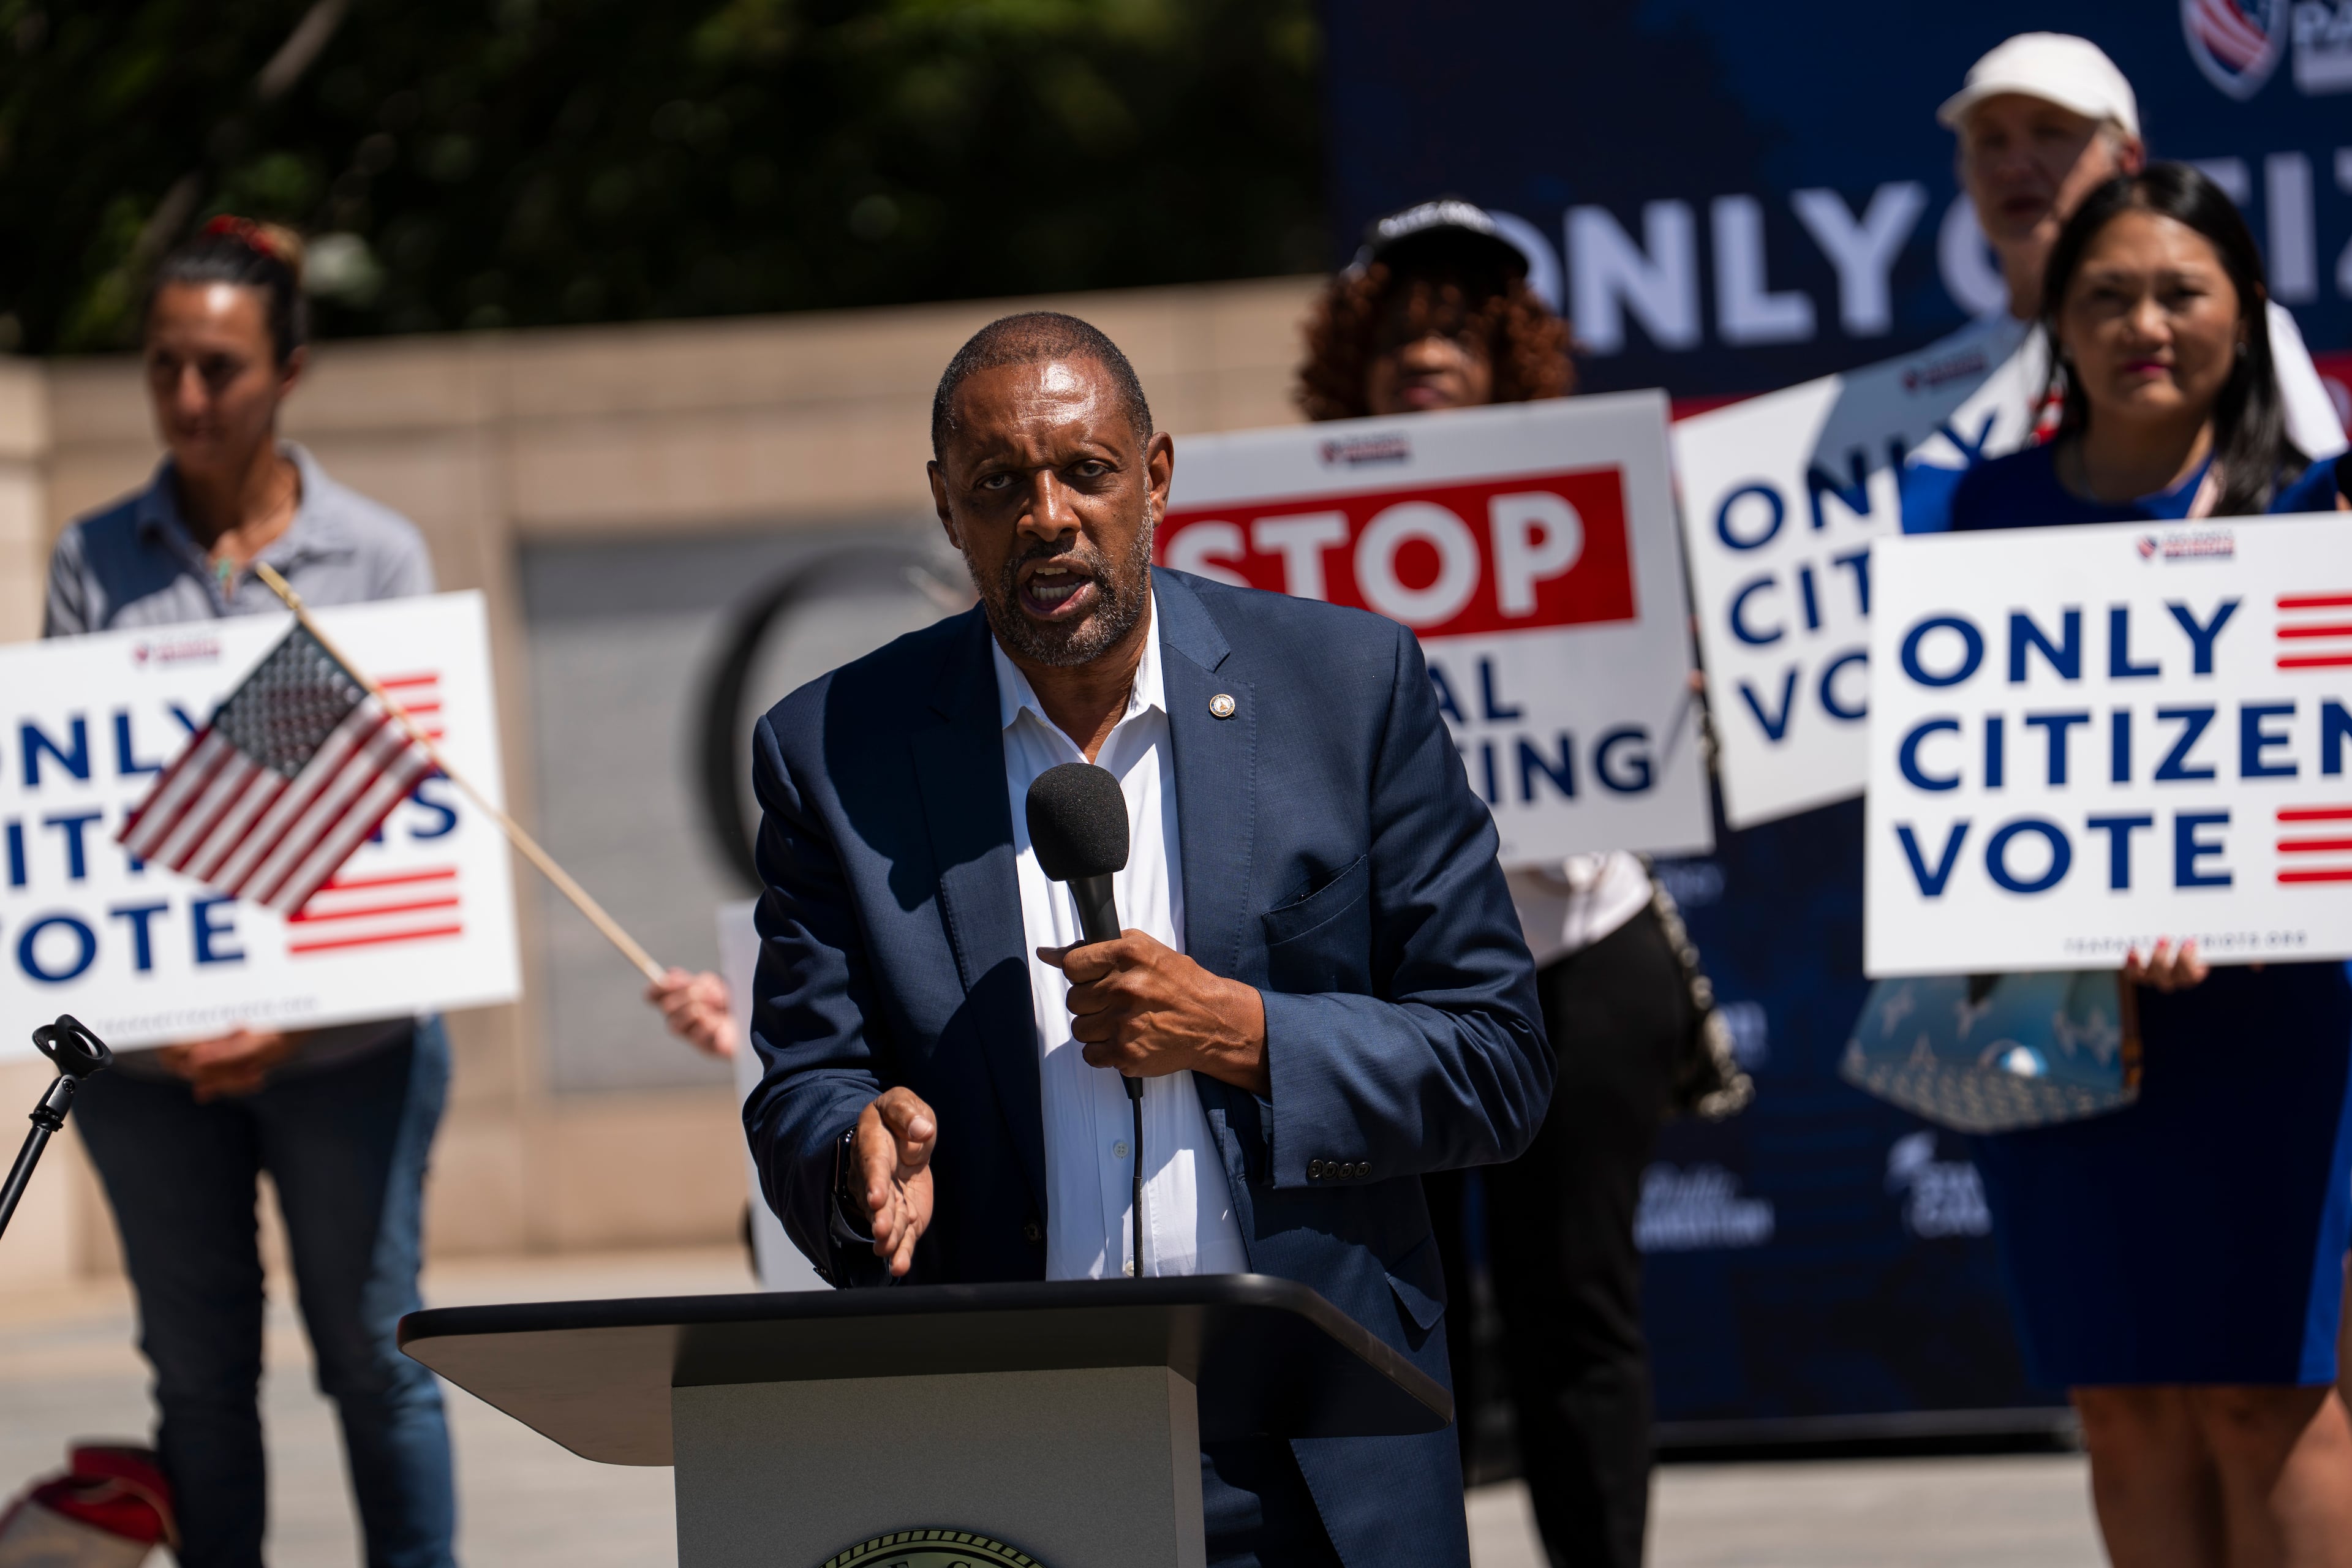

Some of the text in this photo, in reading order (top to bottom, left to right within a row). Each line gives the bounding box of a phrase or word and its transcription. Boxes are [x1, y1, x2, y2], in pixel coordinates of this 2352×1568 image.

[1163, 491, 1584, 626] STOP
[1898, 598, 2242, 690] ONLY
[1457, 724, 1660, 809] ING
[1894, 809, 2234, 899] VOTE
[0, 893, 247, 987] OTE
